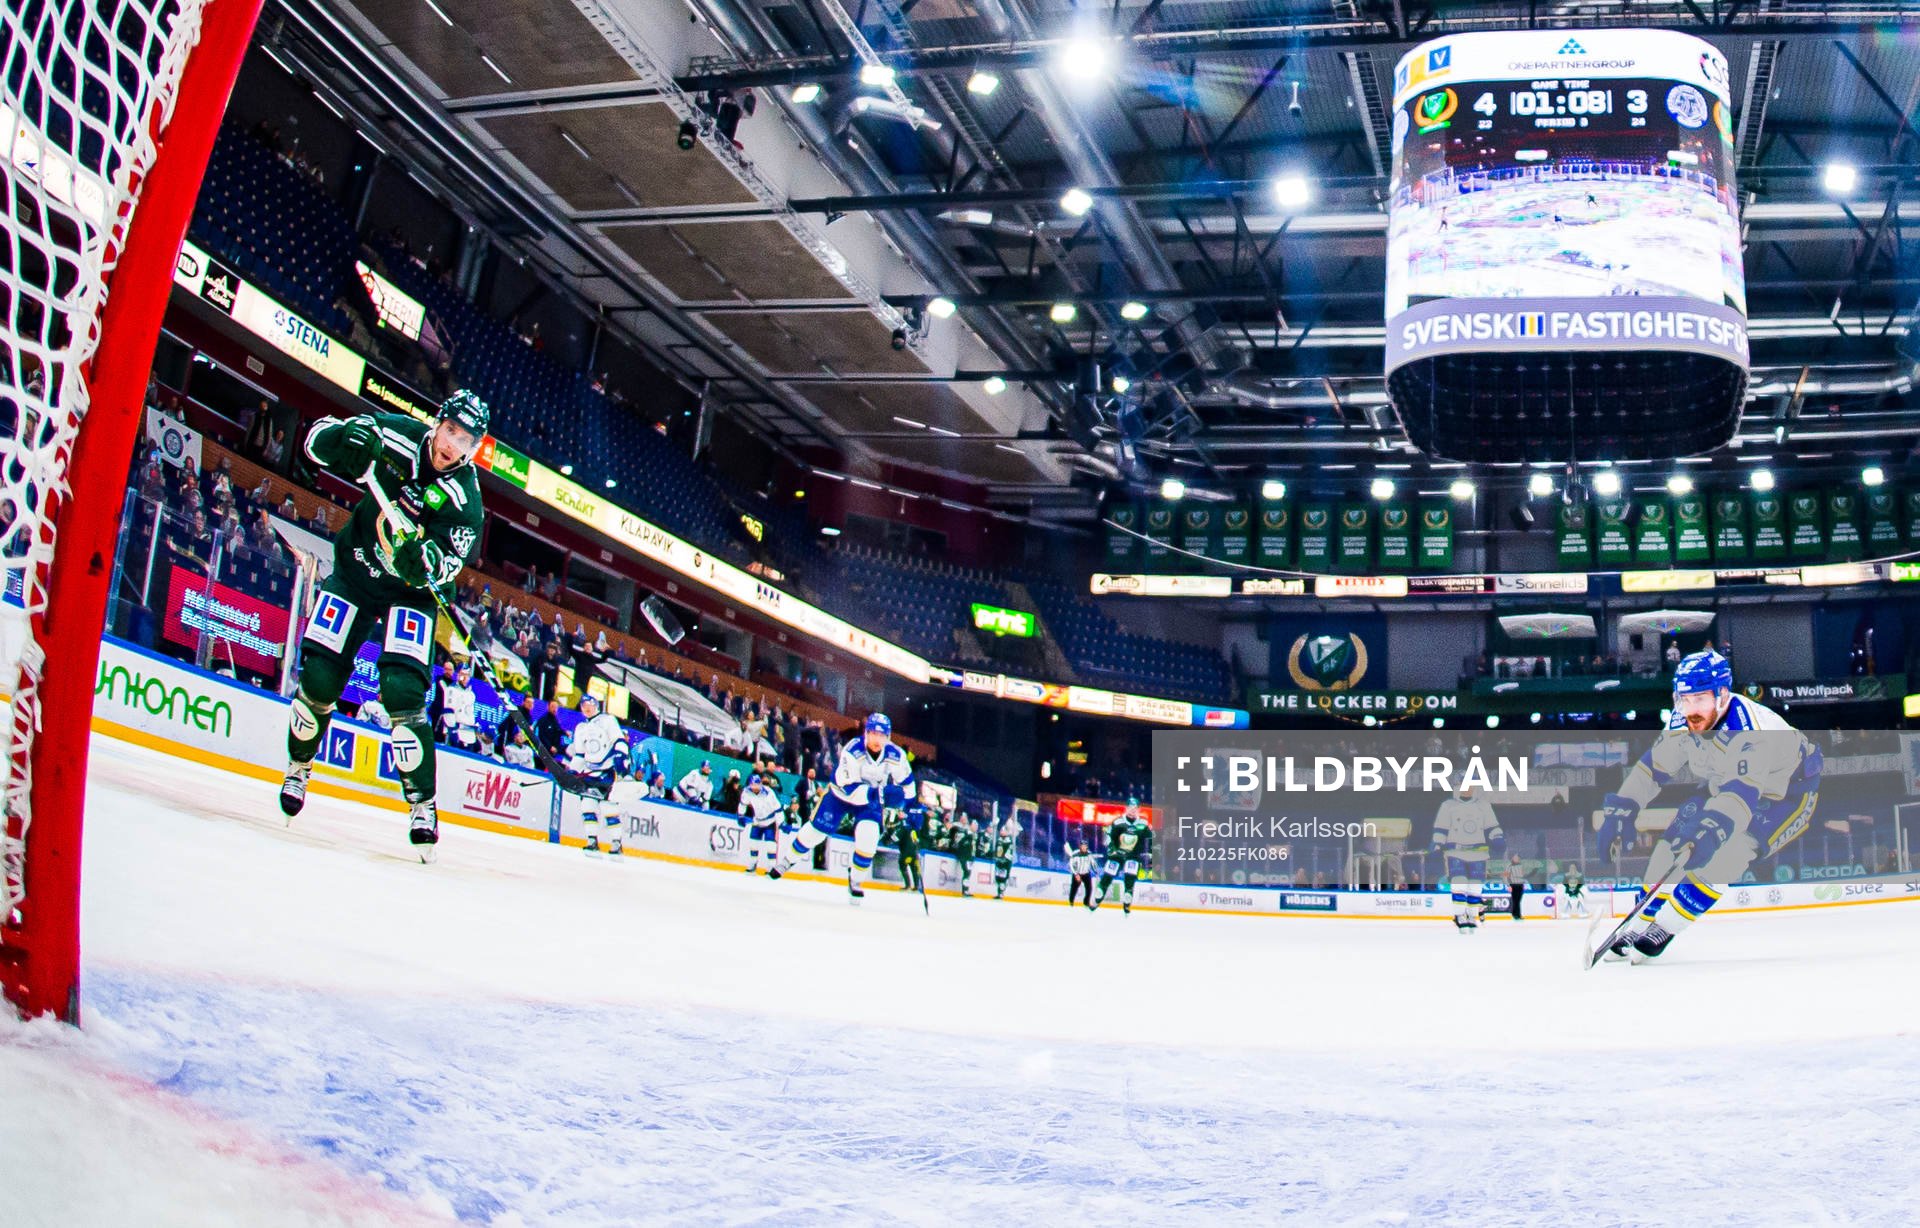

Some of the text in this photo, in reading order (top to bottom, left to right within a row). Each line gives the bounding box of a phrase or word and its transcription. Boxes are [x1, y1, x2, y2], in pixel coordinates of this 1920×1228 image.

[1507, 60, 1635, 71] ONEPARTNERGROUP
[1531, 80, 1590, 90] GAME TIME
[1473, 91, 1497, 116] 4
[1516, 91, 1607, 115] 01:08
[1626, 90, 1648, 114] 3
[1535, 117, 1576, 128] PERIOD
[286, 316, 330, 358] STENA
[1402, 312, 1515, 350] SVENSK
[620, 514, 674, 555] KLARAVIK
[1515, 577, 1586, 591] Sonnelids
[974, 607, 1028, 637] print
[1770, 684, 1854, 698] The Wolfpack
[1260, 694, 1457, 709] THE LOCKER ROOM
[1736, 759, 1748, 777] 8
[1209, 892, 1253, 907] Thermia
